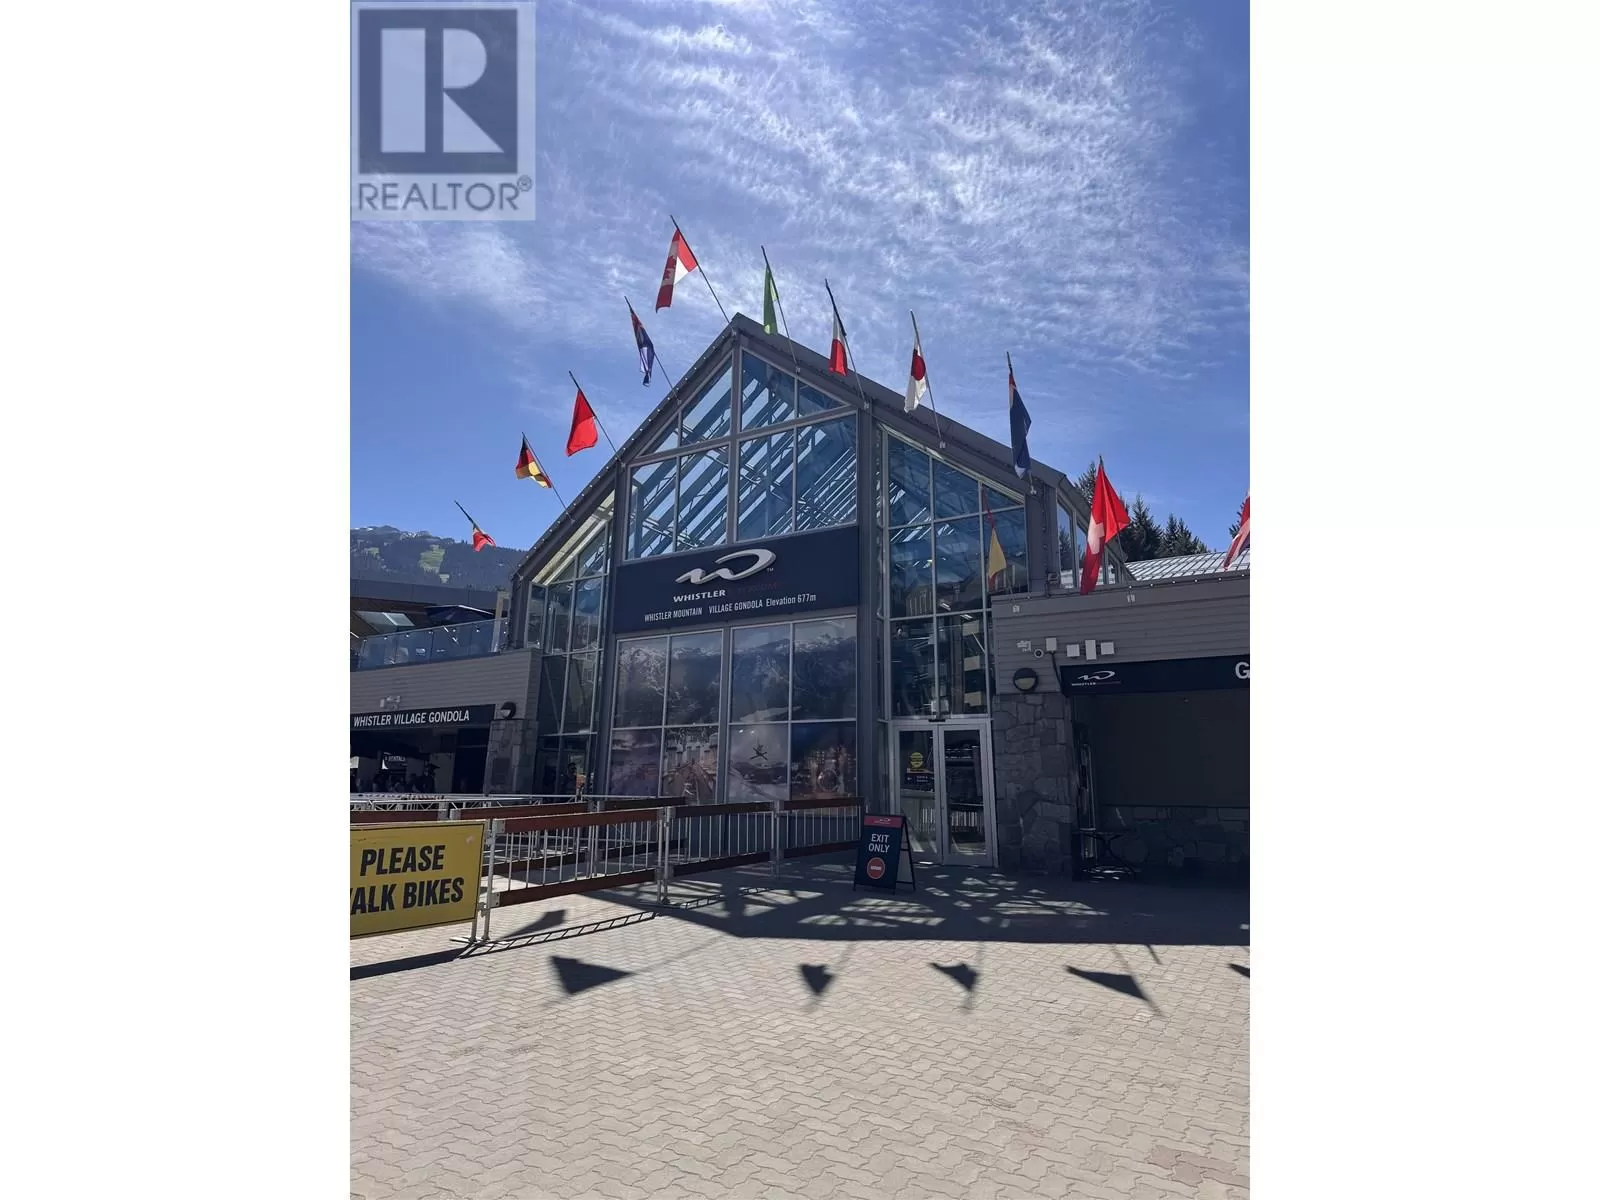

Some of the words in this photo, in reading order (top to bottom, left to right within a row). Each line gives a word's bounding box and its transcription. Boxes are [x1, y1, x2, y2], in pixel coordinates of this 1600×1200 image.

[673, 589, 726, 603] WHISTLER
[644, 611, 672, 622] WHISTLER
[673, 607, 702, 618] MOUNTAIN
[709, 603, 733, 614] VILLAGE
[734, 599, 763, 611] GONDOLA
[766, 596, 796, 607] Elevation
[797, 593, 817, 603] 677m
[353, 714, 392, 727] WHISTLER
[394, 712, 427, 725] VILLAGE
[428, 710, 470, 723] GONDOLA
[871, 833, 890, 843] EXIT
[868, 843, 890, 853] ONLY
[360, 845, 446, 876] PLEASE
[350, 883, 397, 915] ALK
[402, 877, 465, 909] BIKES
